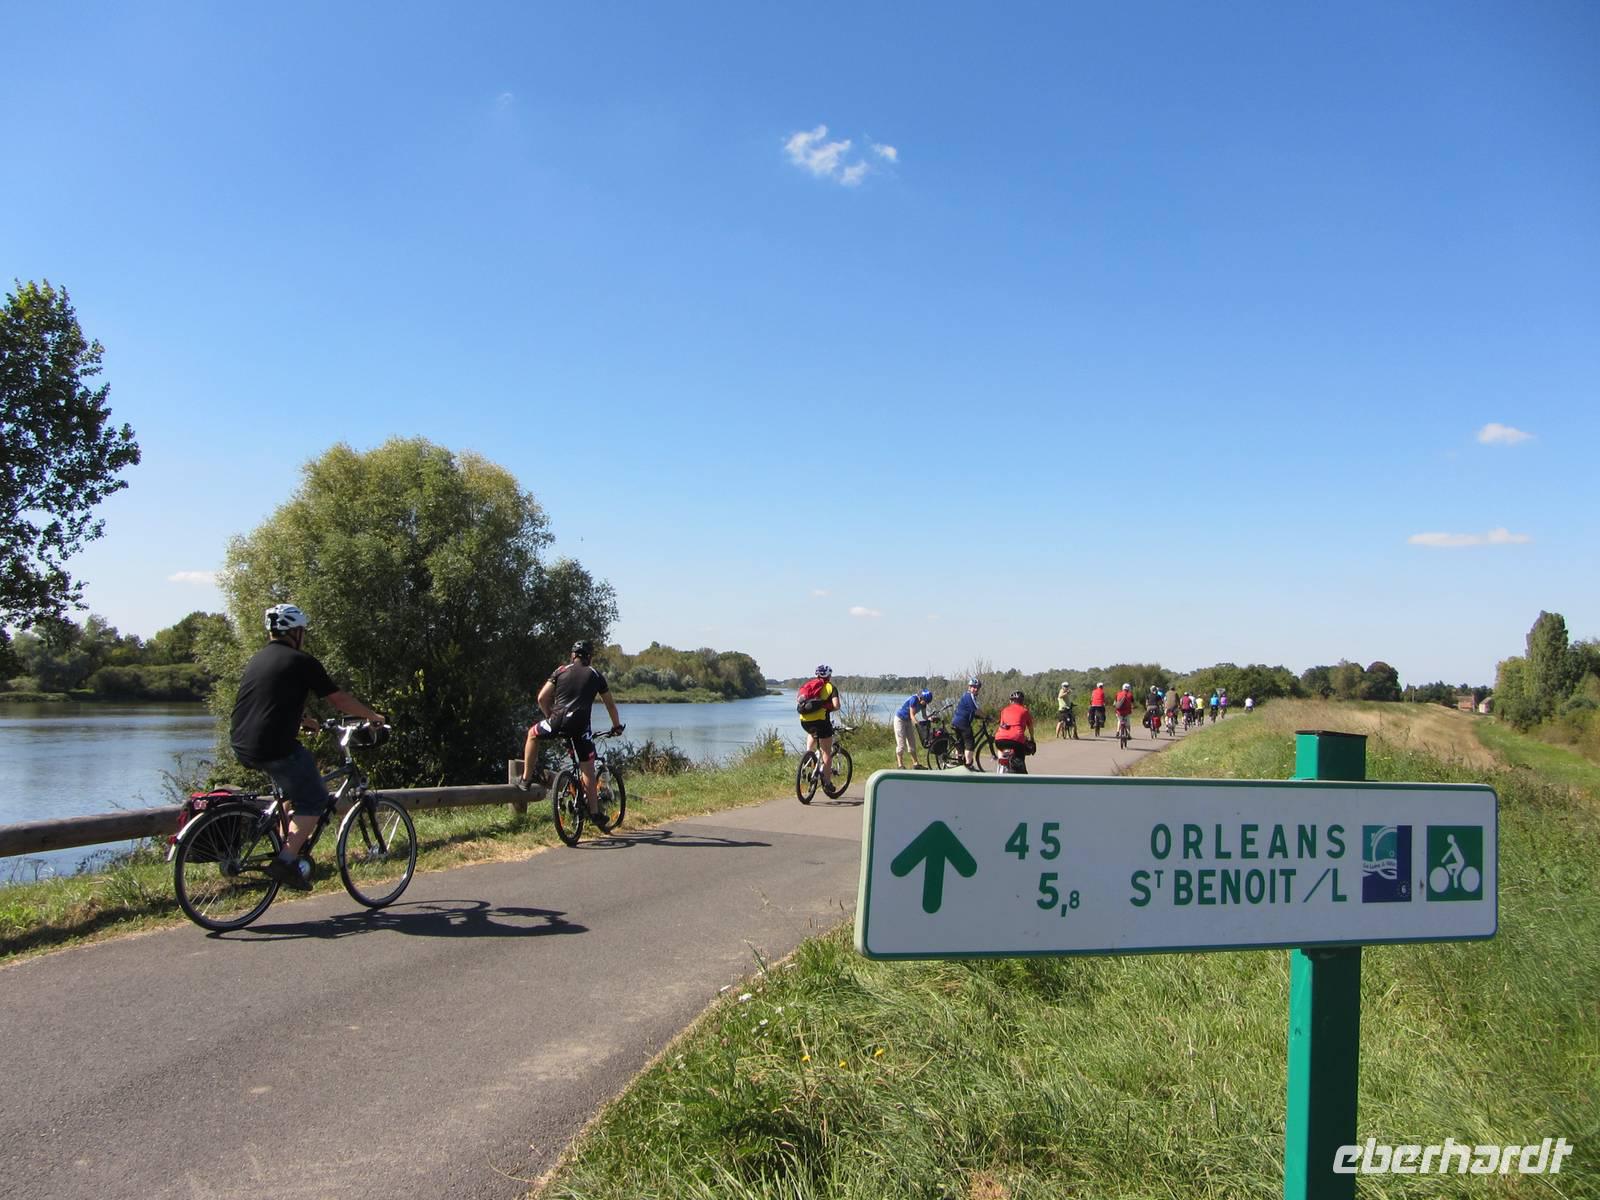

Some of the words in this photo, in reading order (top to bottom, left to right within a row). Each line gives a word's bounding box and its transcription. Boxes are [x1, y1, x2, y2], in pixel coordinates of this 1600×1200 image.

[1004, 822, 1061, 861] 45
[1150, 823, 1346, 860] ORLEANS
[1036, 872, 1080, 917] 5,8
[1173, 868, 1297, 906] BENOIT
